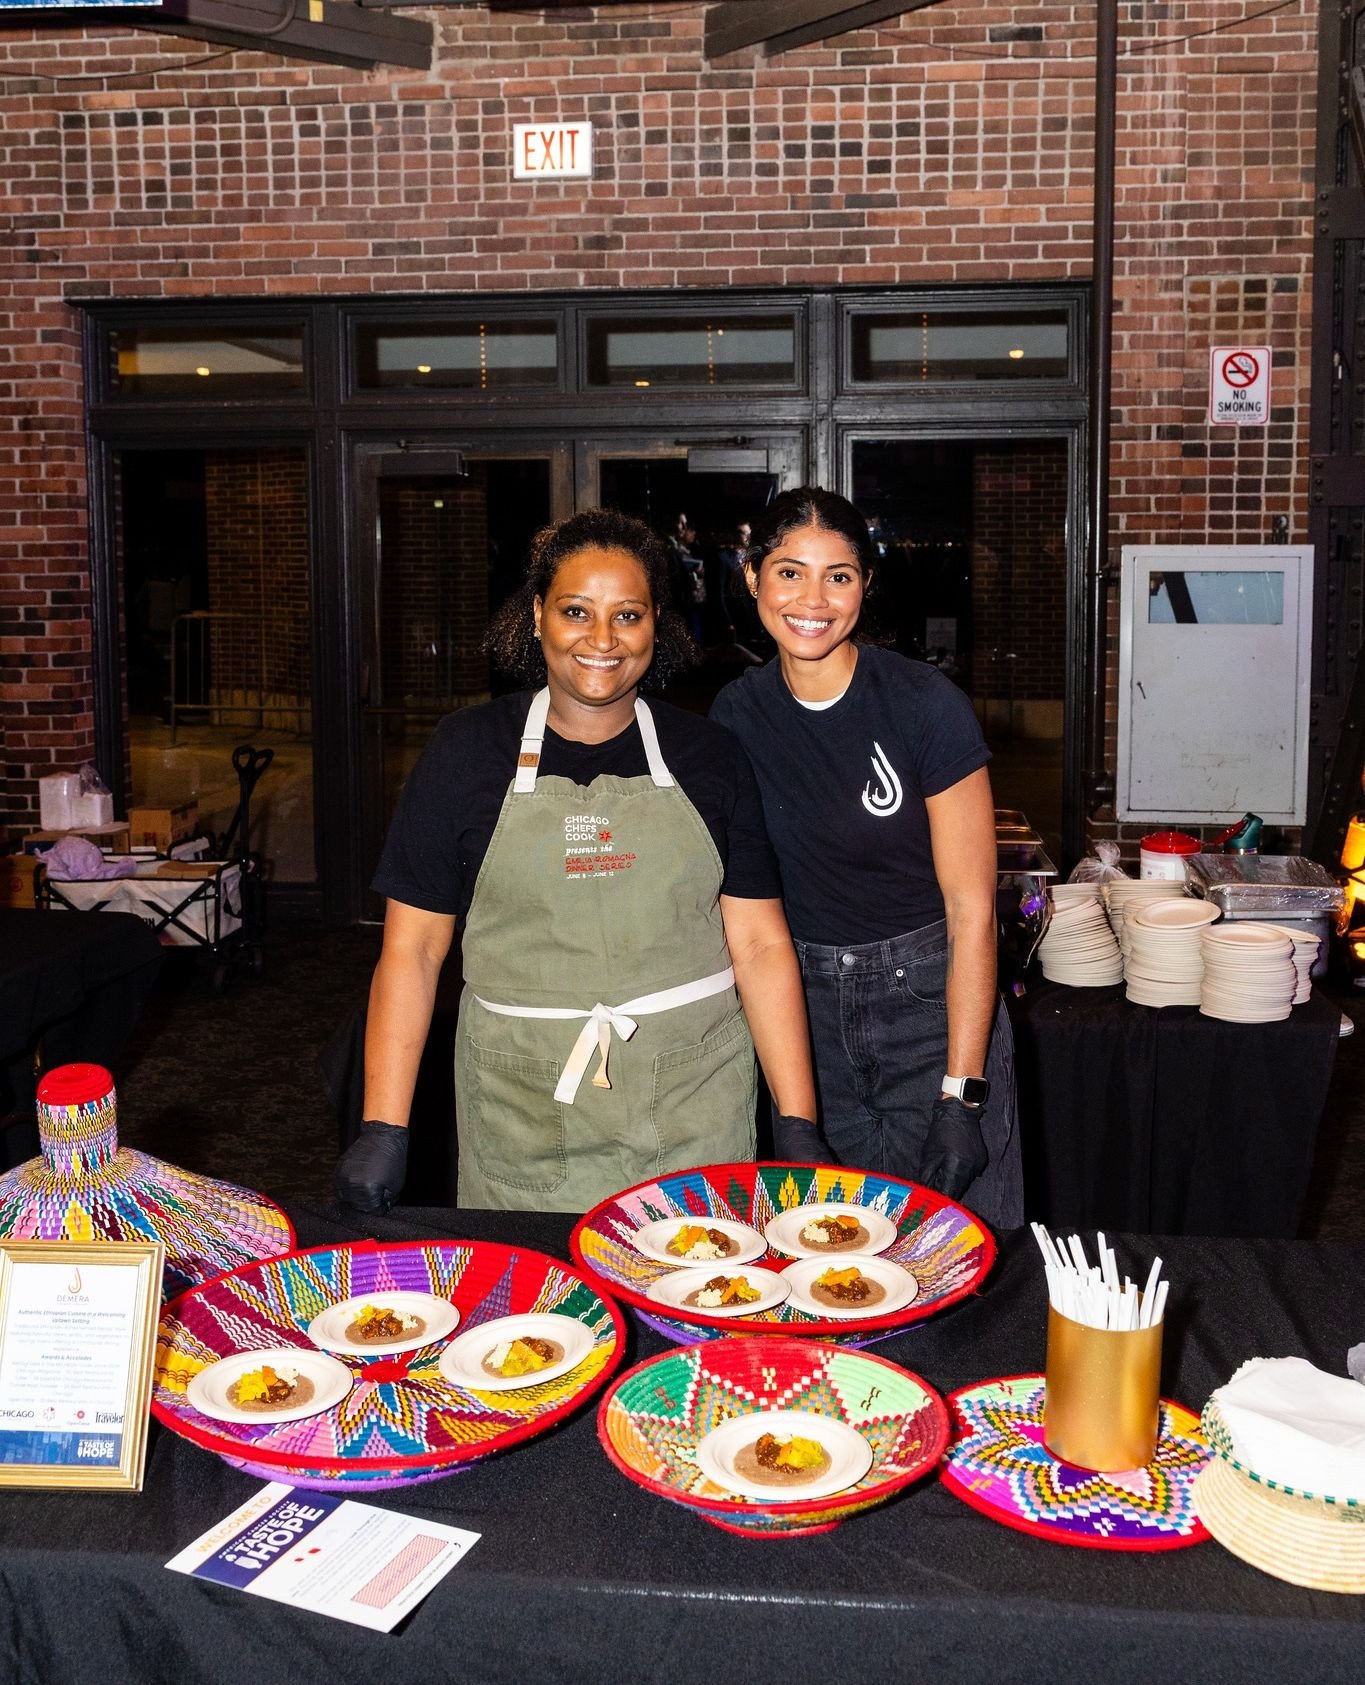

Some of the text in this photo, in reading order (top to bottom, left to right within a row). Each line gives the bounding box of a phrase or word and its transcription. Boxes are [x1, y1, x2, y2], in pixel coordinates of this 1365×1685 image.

[524, 130, 579, 170] EXIT
[1233, 389, 1247, 400] NO
[1218, 402, 1262, 412] SMOKING
[565, 816, 609, 825] CHICAGO
[565, 824, 597, 833] CHEFS
[565, 833, 596, 841] COOK
[565, 843, 613, 856] presents the
[57, 1295, 90, 1303] DEMERA
[95, 1411, 125, 1424] Traveler
[82, 1447, 114, 1458] HOPE
[198, 1496, 272, 1553] WELCOME TO
[233, 1501, 300, 1552] TASTE OF
[246, 1505, 325, 1561] HOPE
